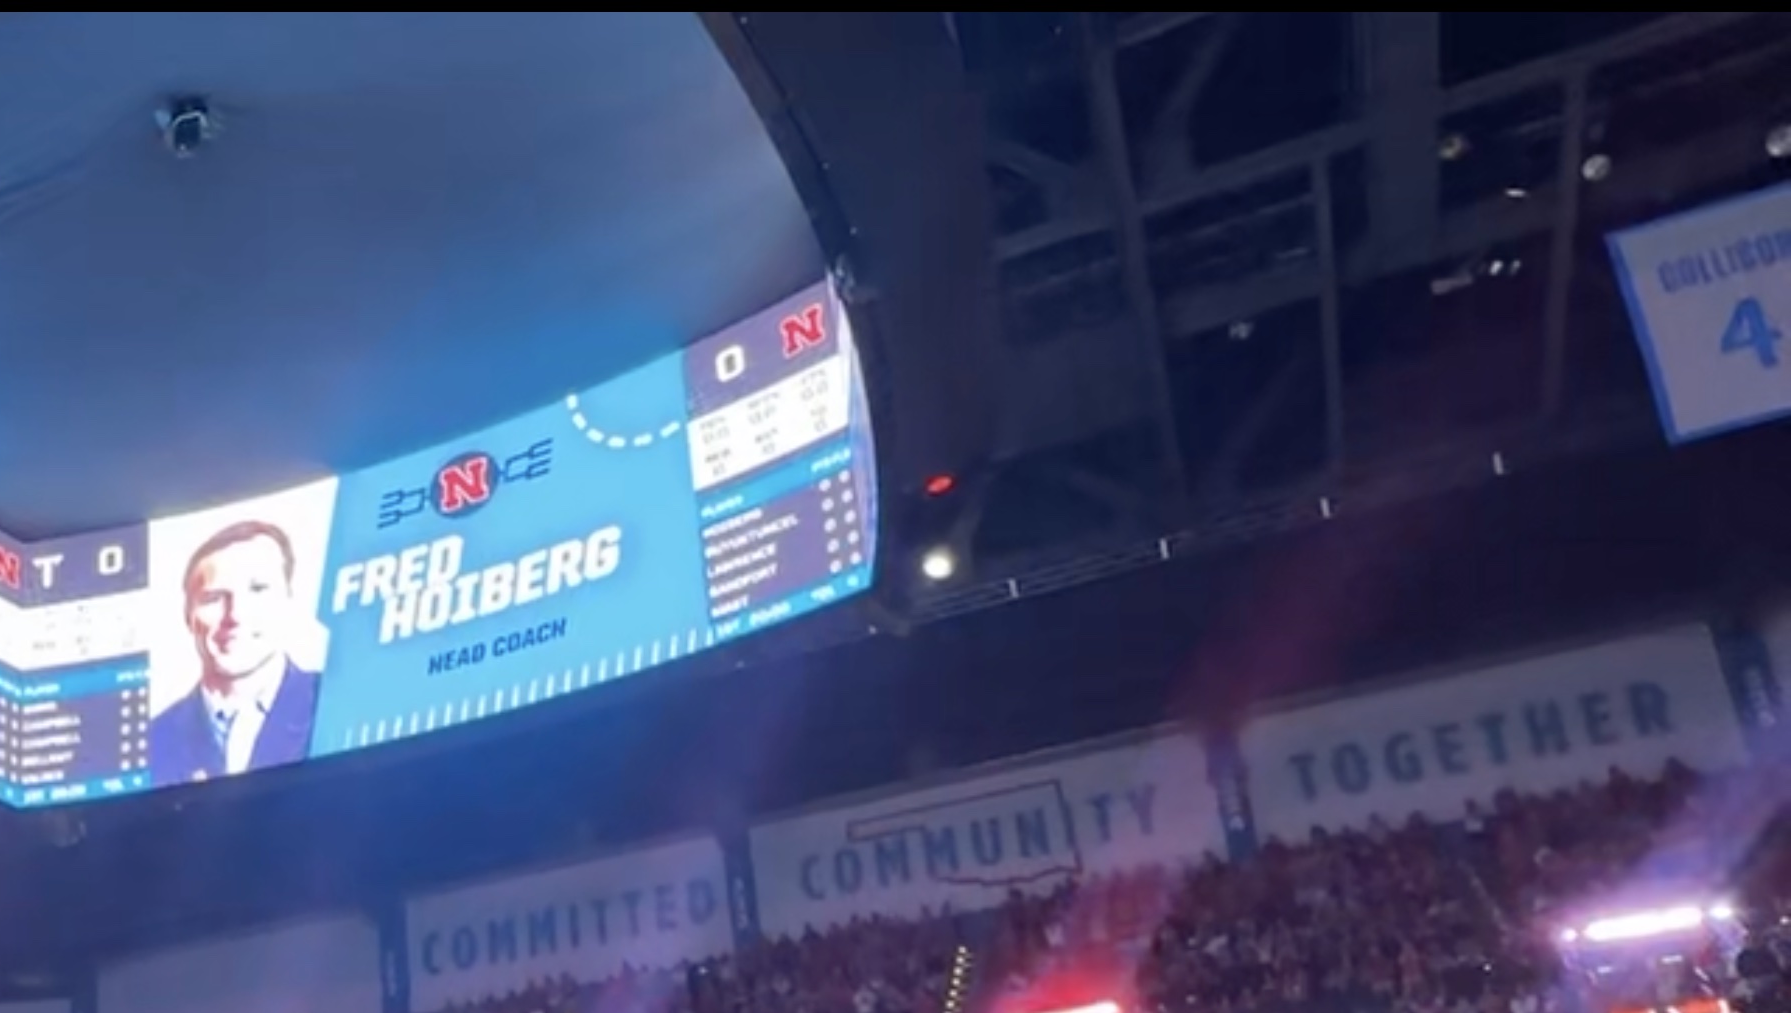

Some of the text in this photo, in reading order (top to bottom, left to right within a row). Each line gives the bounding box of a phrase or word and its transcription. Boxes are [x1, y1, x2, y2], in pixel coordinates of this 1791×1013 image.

[715, 303, 825, 382] 0 N
[1721, 296, 1782, 368] 4
[438, 455, 491, 514] N
[32, 554, 64, 589] T
[98, 545, 124, 575] 0
[331, 534, 464, 614] FRED
[378, 524, 623, 645] HOIBERG
[428, 617, 568, 676] HEAD COACH
[1288, 681, 1675, 801] TOGETHER
[799, 782, 1159, 901] COMMUNITY
[420, 878, 716, 976] COMMITTED
